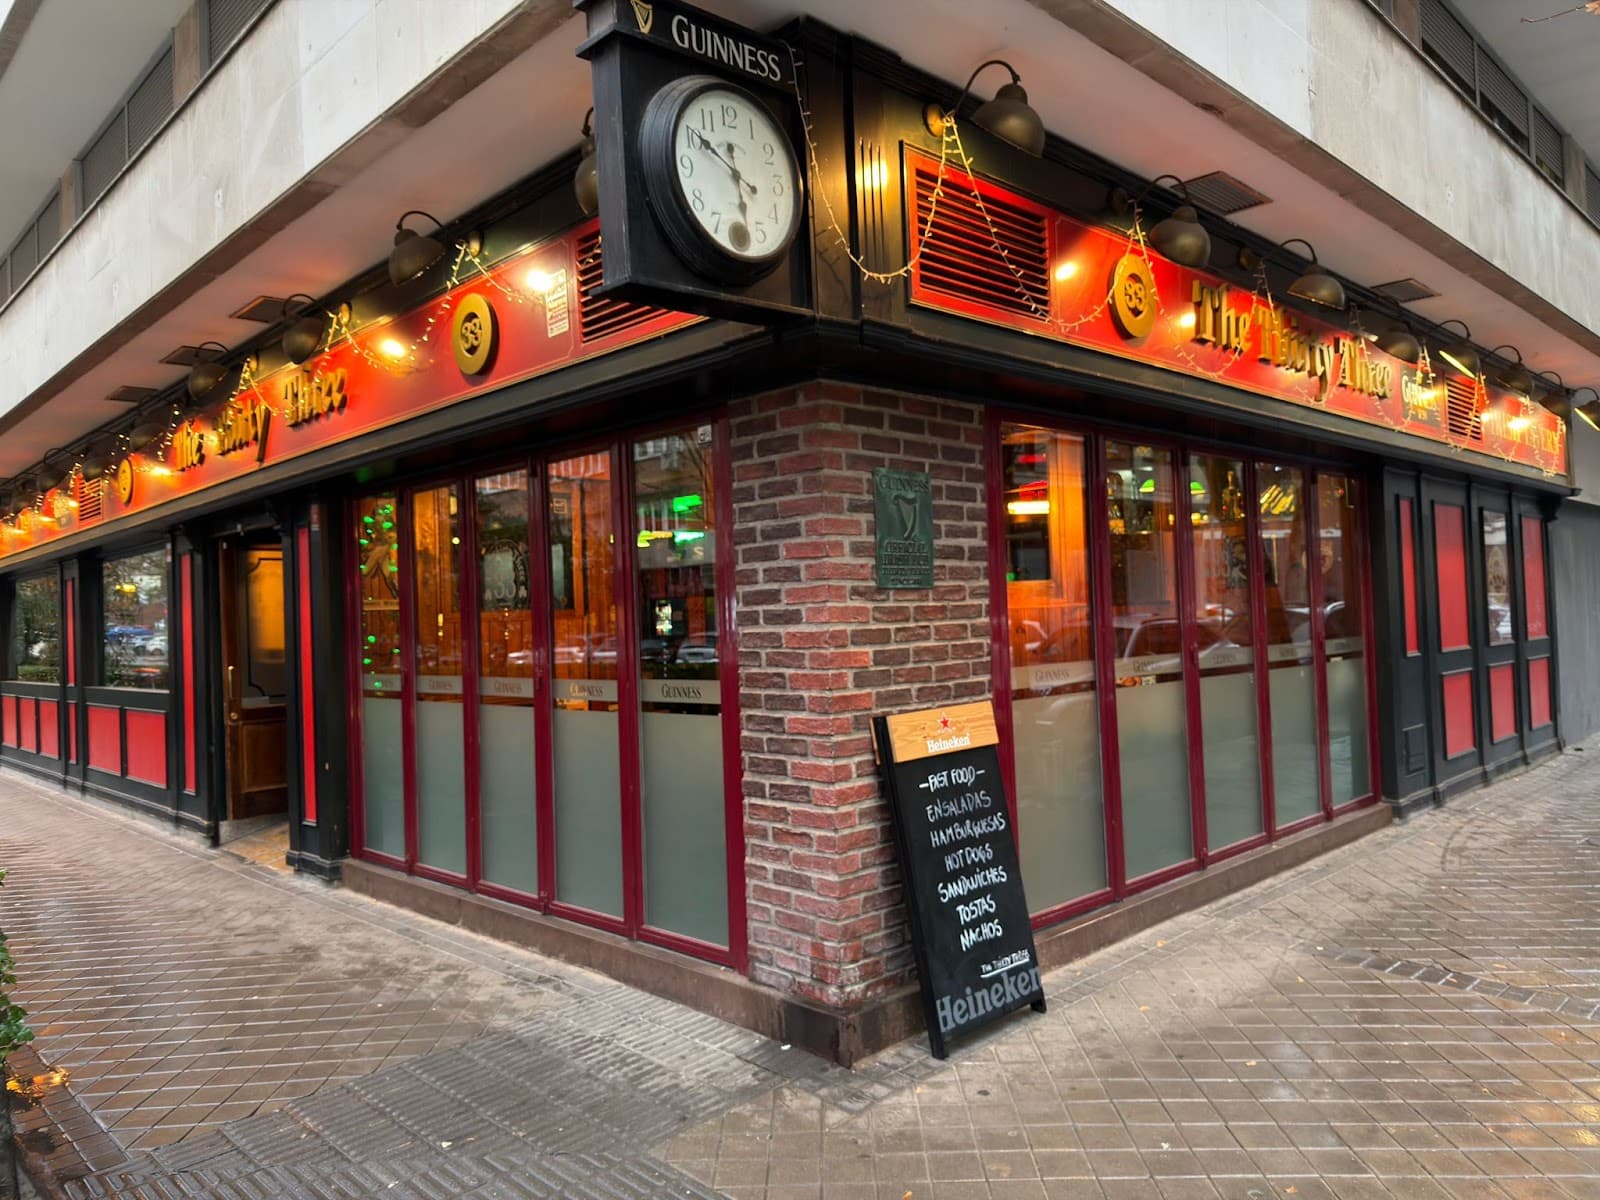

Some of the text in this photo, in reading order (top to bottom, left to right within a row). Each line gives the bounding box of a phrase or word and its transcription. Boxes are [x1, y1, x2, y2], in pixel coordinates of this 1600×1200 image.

[671, 14, 782, 82] GUINNESS
[700, 108, 715, 133] 11
[721, 104, 738, 129] 12
[686, 124, 702, 149] 10
[749, 119, 754, 140] 1
[680, 155, 694, 178] 9
[762, 143, 775, 166] 2
[772, 174, 784, 197] 3
[692, 189, 705, 212] 8
[710, 211, 721, 234] 7
[767, 203, 779, 225] 4
[754, 222, 767, 244] 5
[462, 318, 481, 349] 33
[1192, 280, 1393, 402] The Thirty Three
[284, 366, 348, 428] Three
[661, 683, 702, 699] GUINNESS
[927, 735, 971, 753] Heineken
[925, 790, 992, 822] ENSALADAS
[930, 812, 1006, 848] HAMBURGUESAS
[944, 843, 993, 872] HOT DOGS
[956, 894, 996, 925] TOSTAS
[959, 918, 1003, 952] NACHOS
[935, 966, 1042, 1032] Heineken
